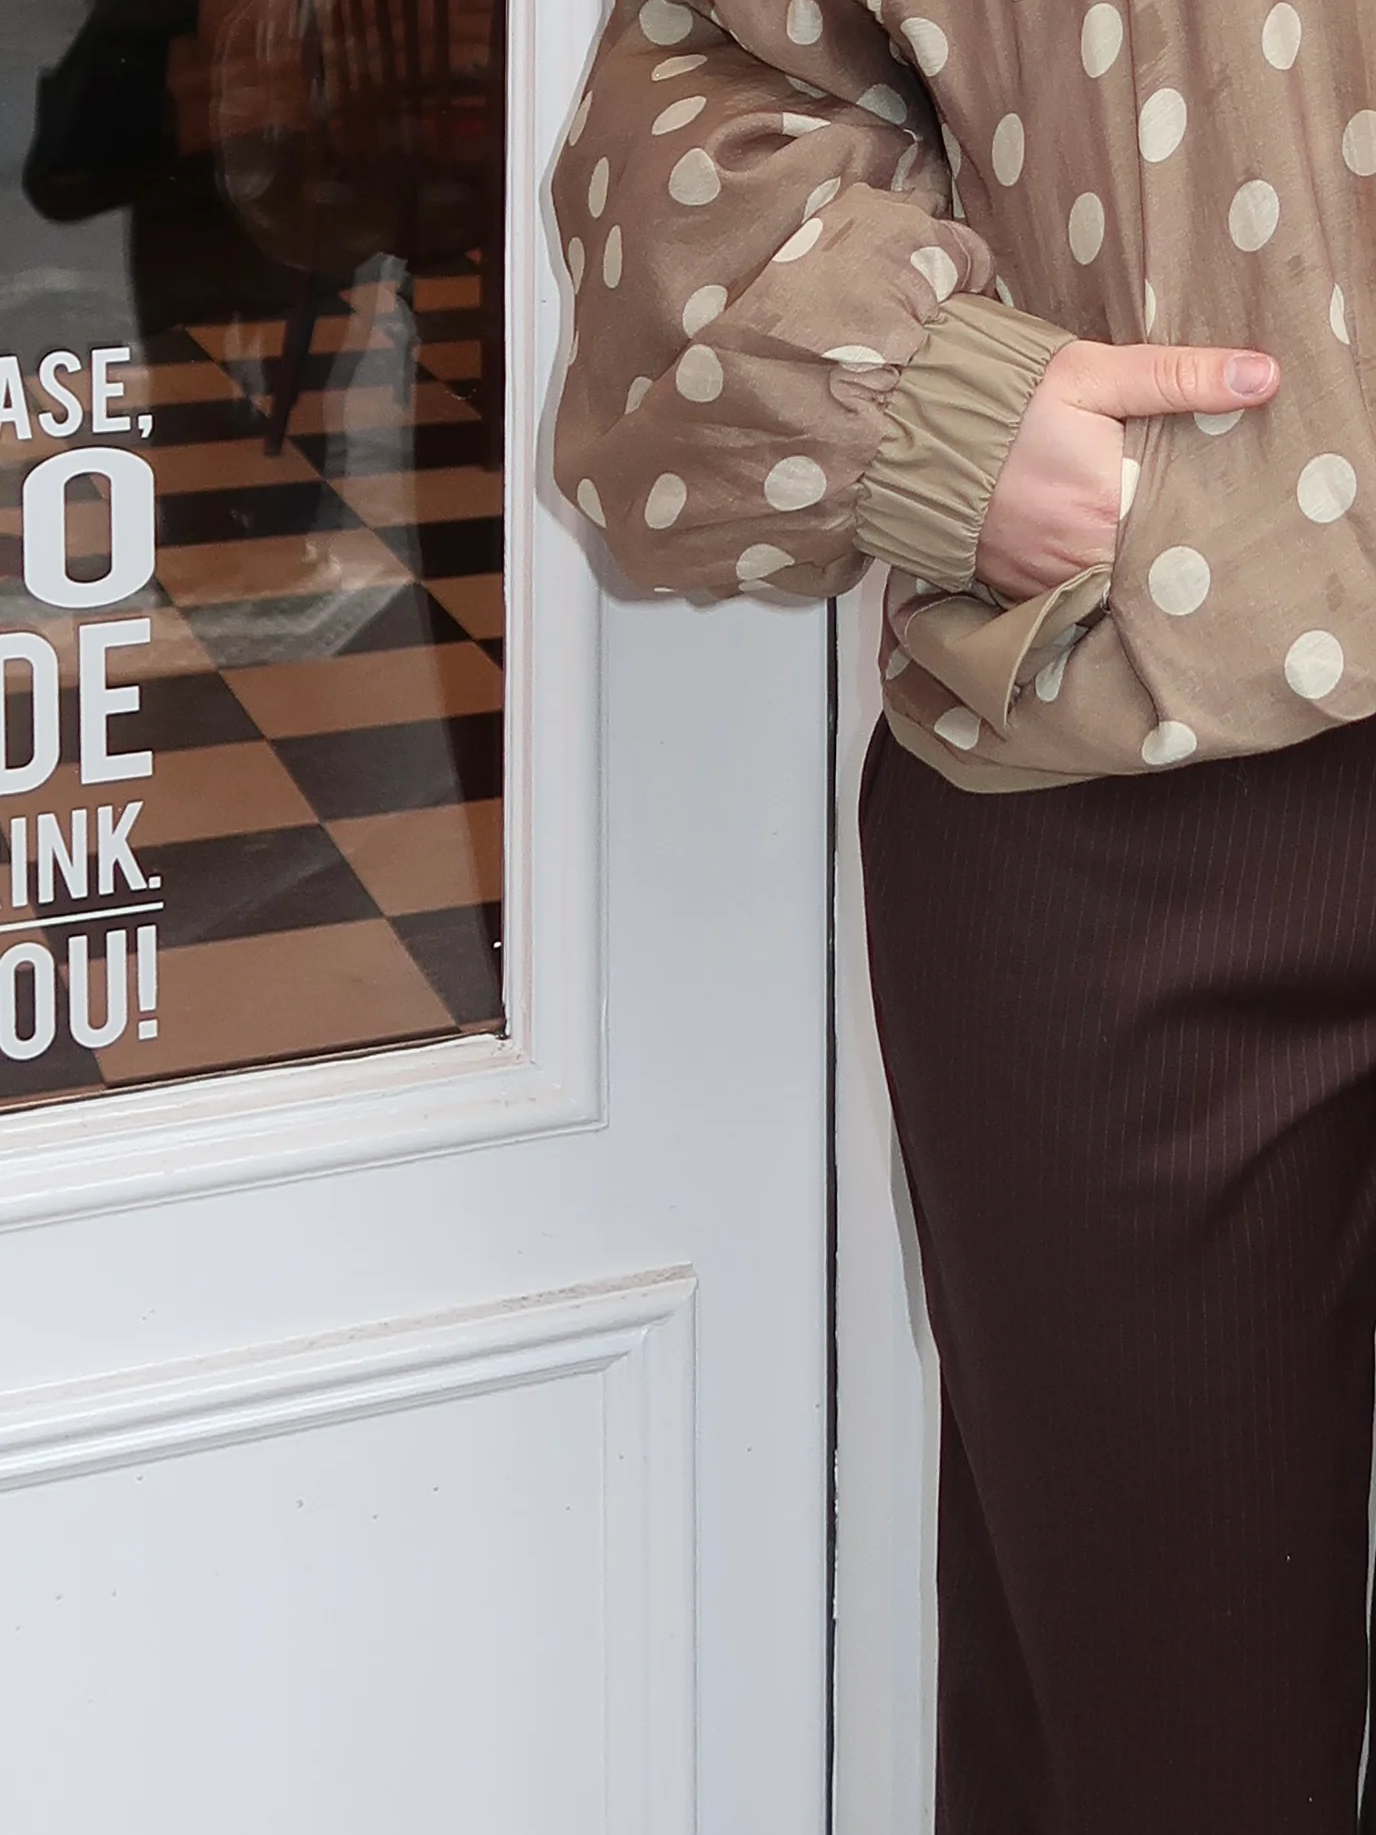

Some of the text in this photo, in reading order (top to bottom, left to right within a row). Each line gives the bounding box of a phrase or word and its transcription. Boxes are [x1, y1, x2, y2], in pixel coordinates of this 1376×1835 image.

[0, 347, 153, 440] ASE,
[23, 447, 155, 609] O
[0, 617, 153, 795] DE
[0, 924, 158, 1061] OU!
